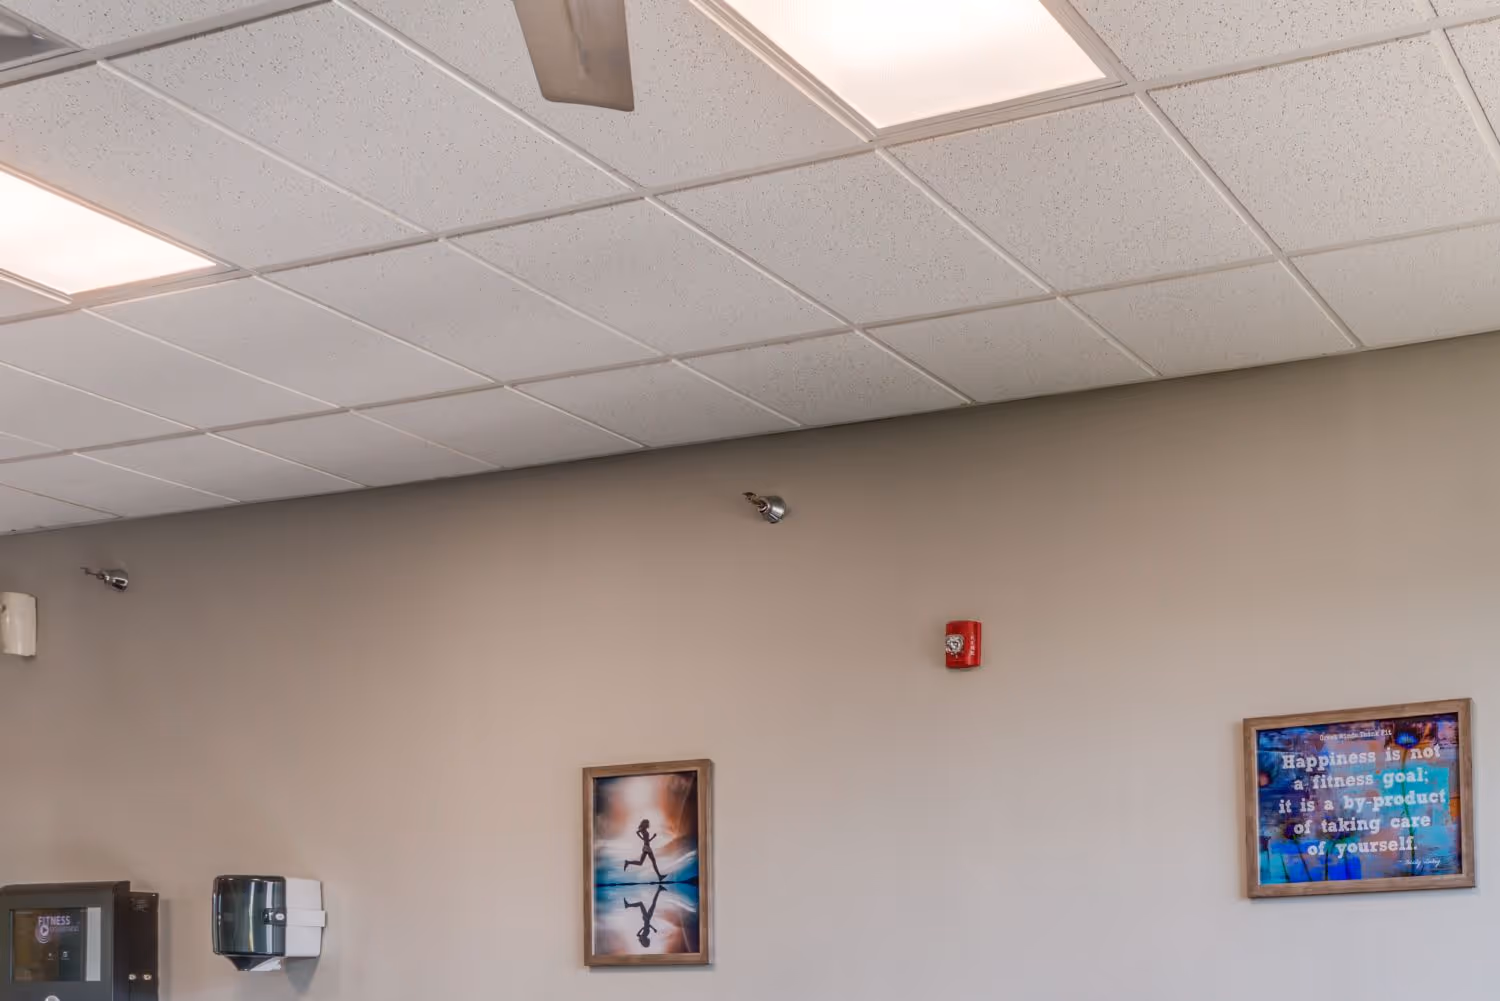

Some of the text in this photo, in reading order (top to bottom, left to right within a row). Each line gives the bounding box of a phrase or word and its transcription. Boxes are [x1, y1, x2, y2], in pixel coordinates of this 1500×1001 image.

[1282, 743, 1441, 771] Happiness is not
[1293, 768, 1429, 790] a fitness goal;
[1279, 790, 1446, 814] it is a by-product
[1293, 816, 1431, 835] of taking care
[1307, 836, 1417, 858] of yourself.
[38, 916, 71, 926] FITNESS
